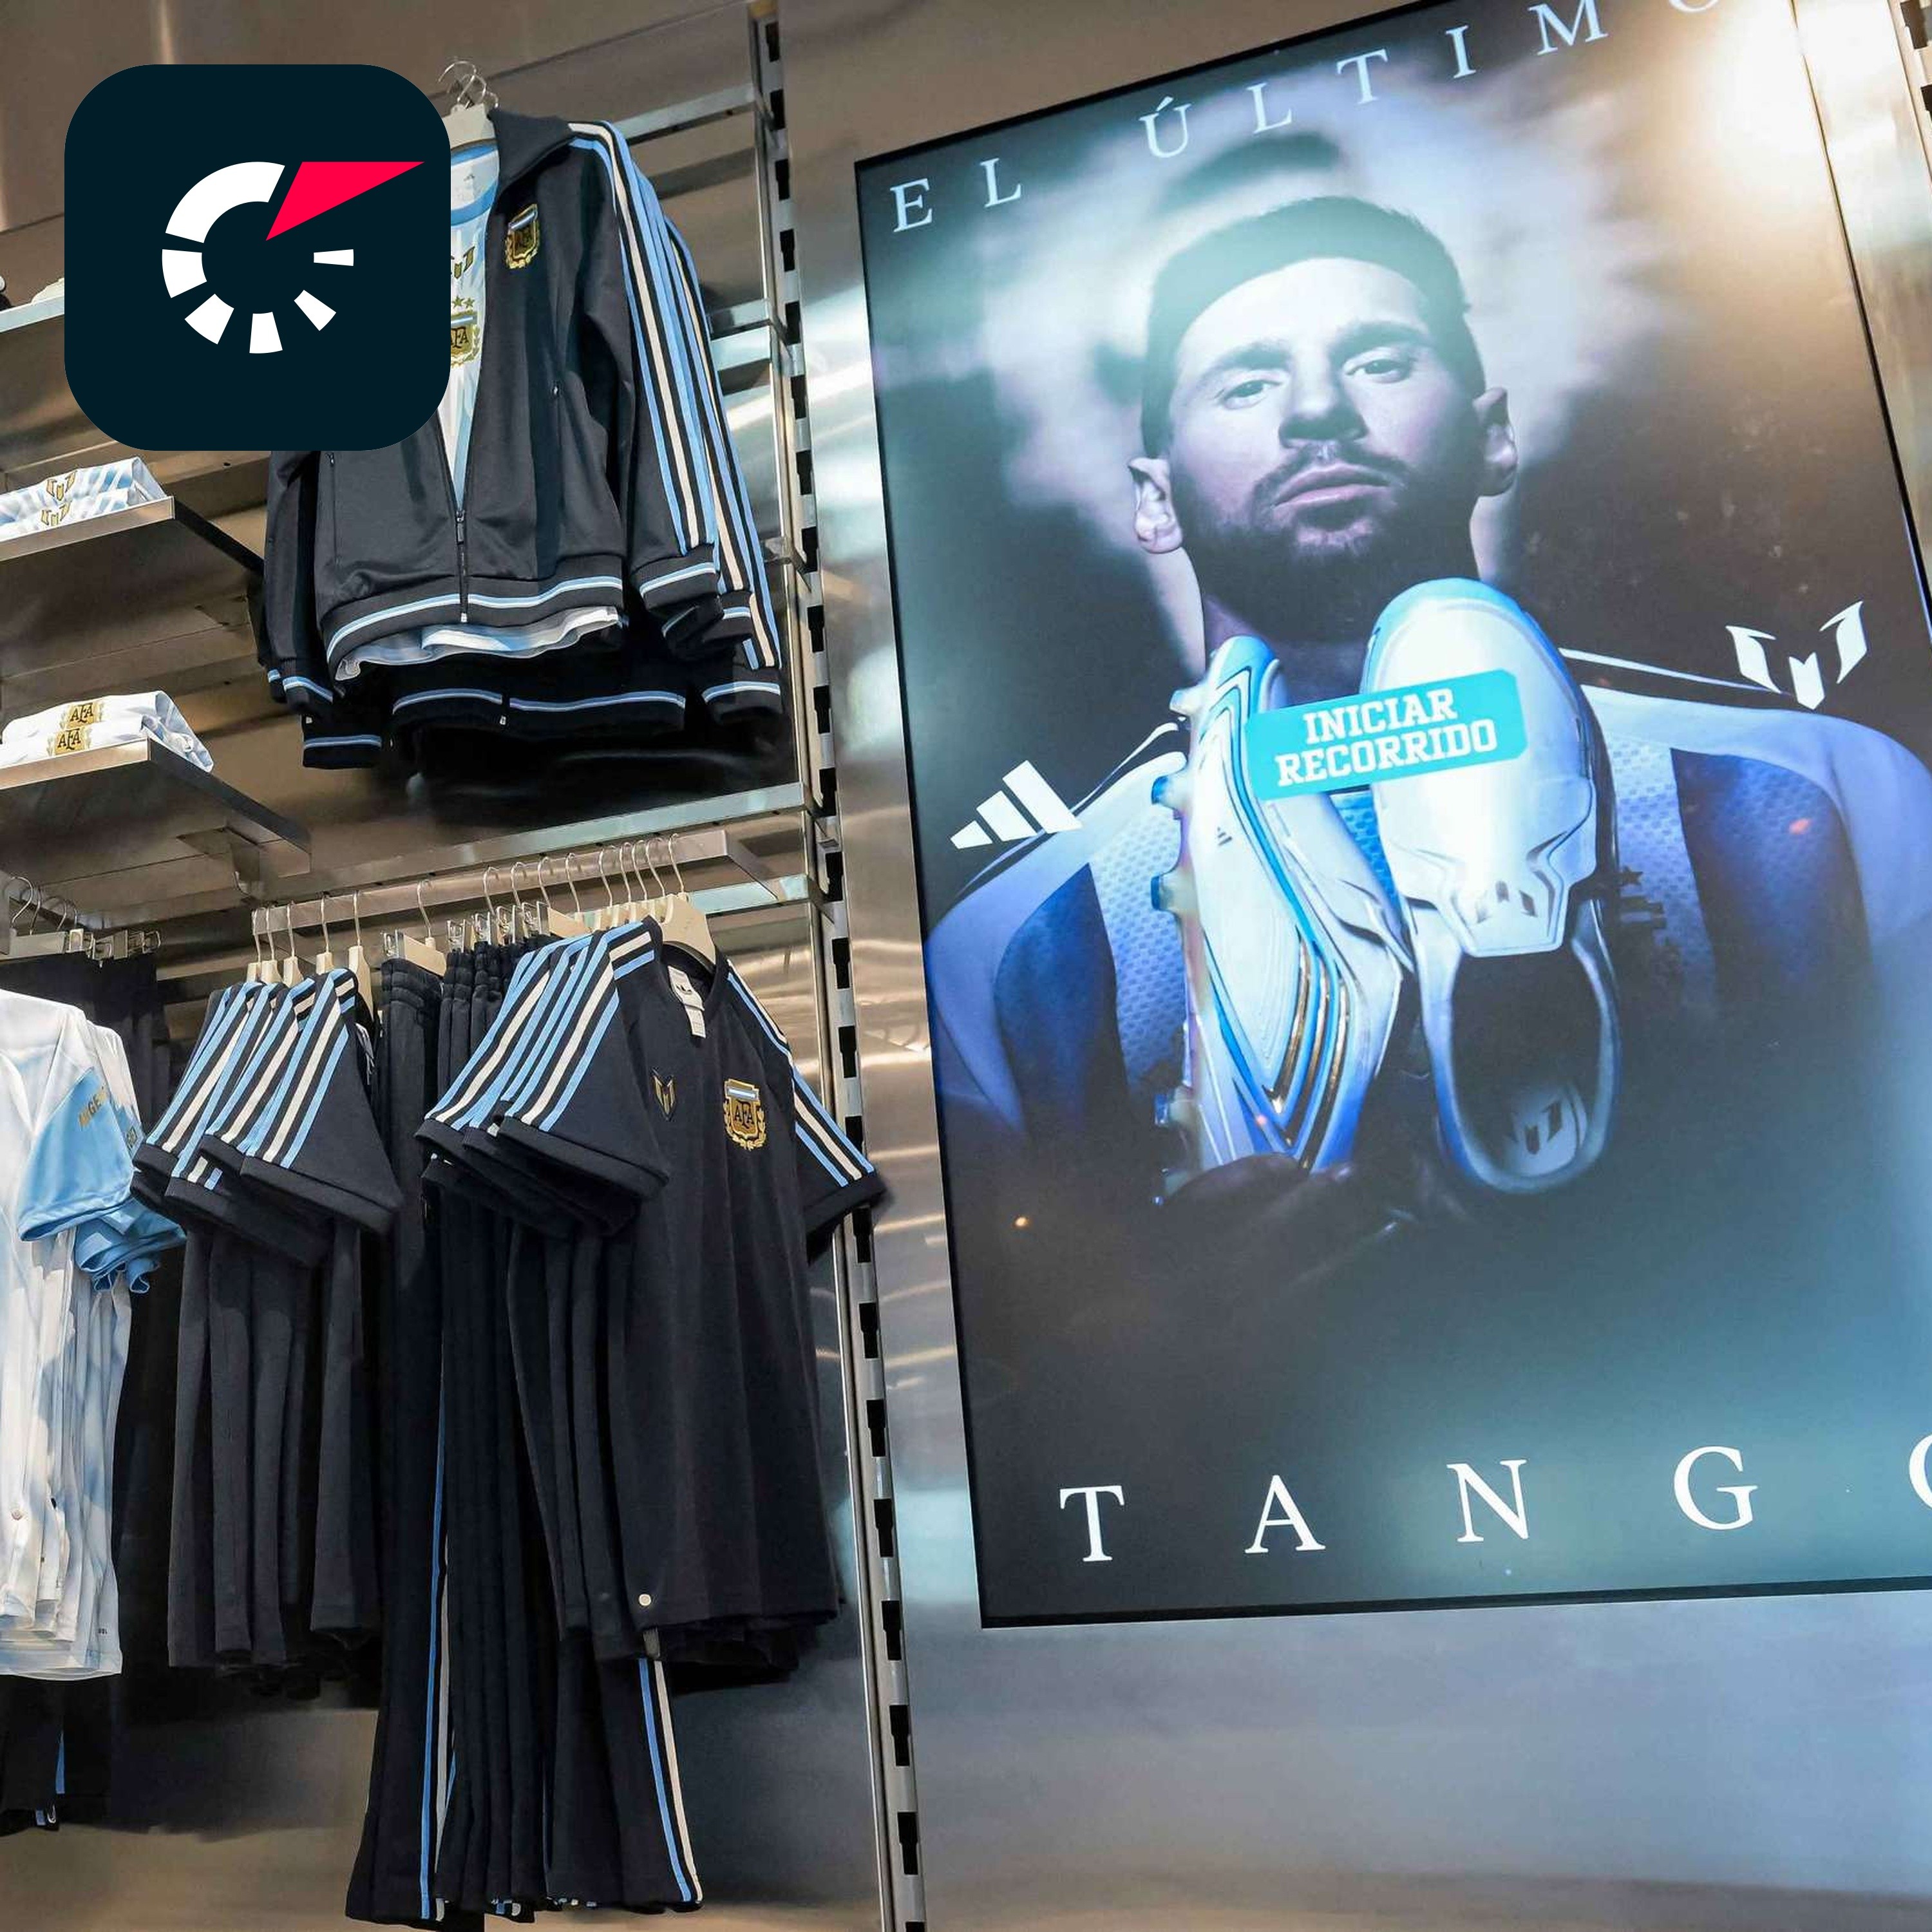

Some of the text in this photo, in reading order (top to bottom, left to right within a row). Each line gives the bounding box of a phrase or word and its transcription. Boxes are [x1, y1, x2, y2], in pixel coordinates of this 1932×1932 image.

[890, 0, 1718, 232] EL ÚLTIM
[451, 326, 469, 348] FA
[70, 702, 93, 723] AFA
[1303, 687, 1458, 745] INICIAR
[57, 728, 81, 750] AFA
[1274, 718, 1499, 788] RECORRIDO
[734, 1099, 755, 1130] AFA
